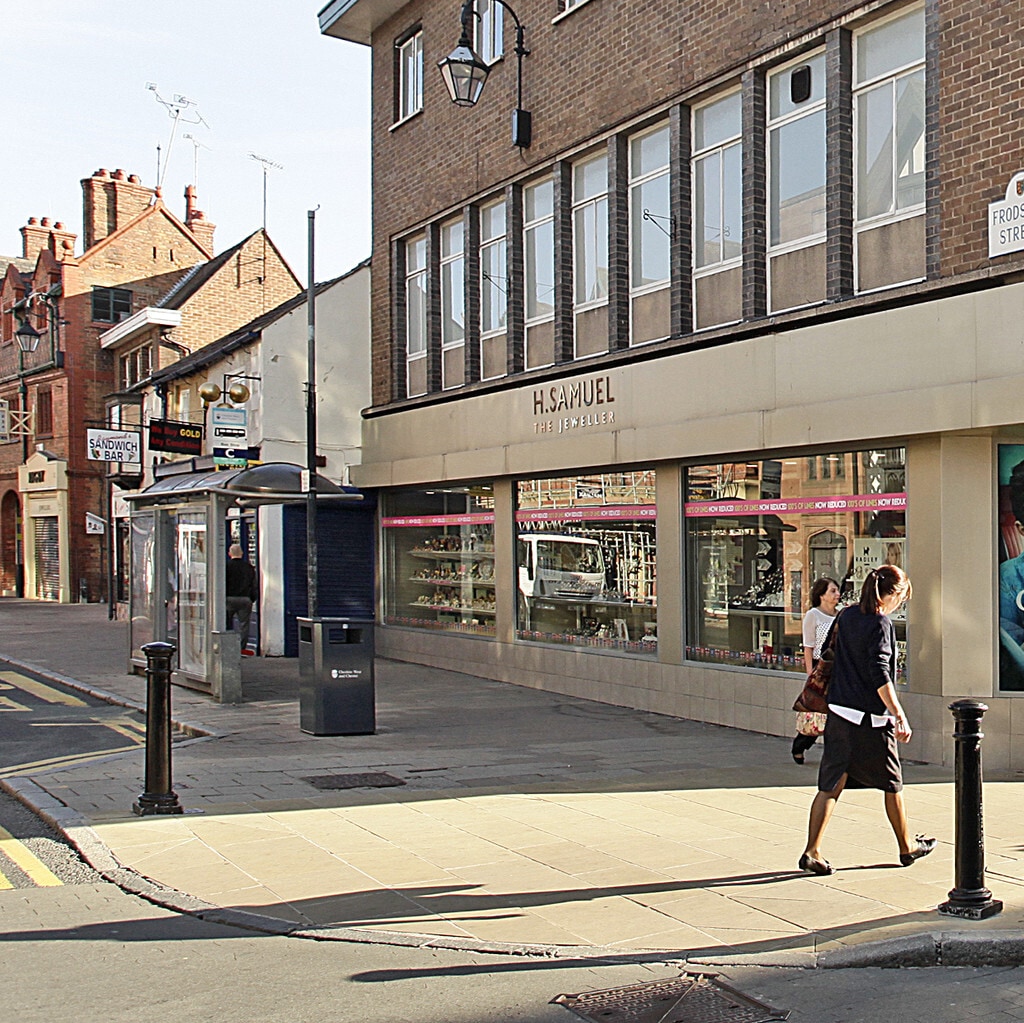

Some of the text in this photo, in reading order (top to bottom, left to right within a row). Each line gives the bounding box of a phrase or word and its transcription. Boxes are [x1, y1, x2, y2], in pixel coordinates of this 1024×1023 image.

[533, 376, 615, 415] H.SAMUEL
[533, 411, 615, 434] THE JEWELLER
[180, 428, 200, 438] GOLD
[89, 438, 138, 452] SANDWICH
[105, 450, 124, 461] BAR
[225, 448, 235, 458] C
